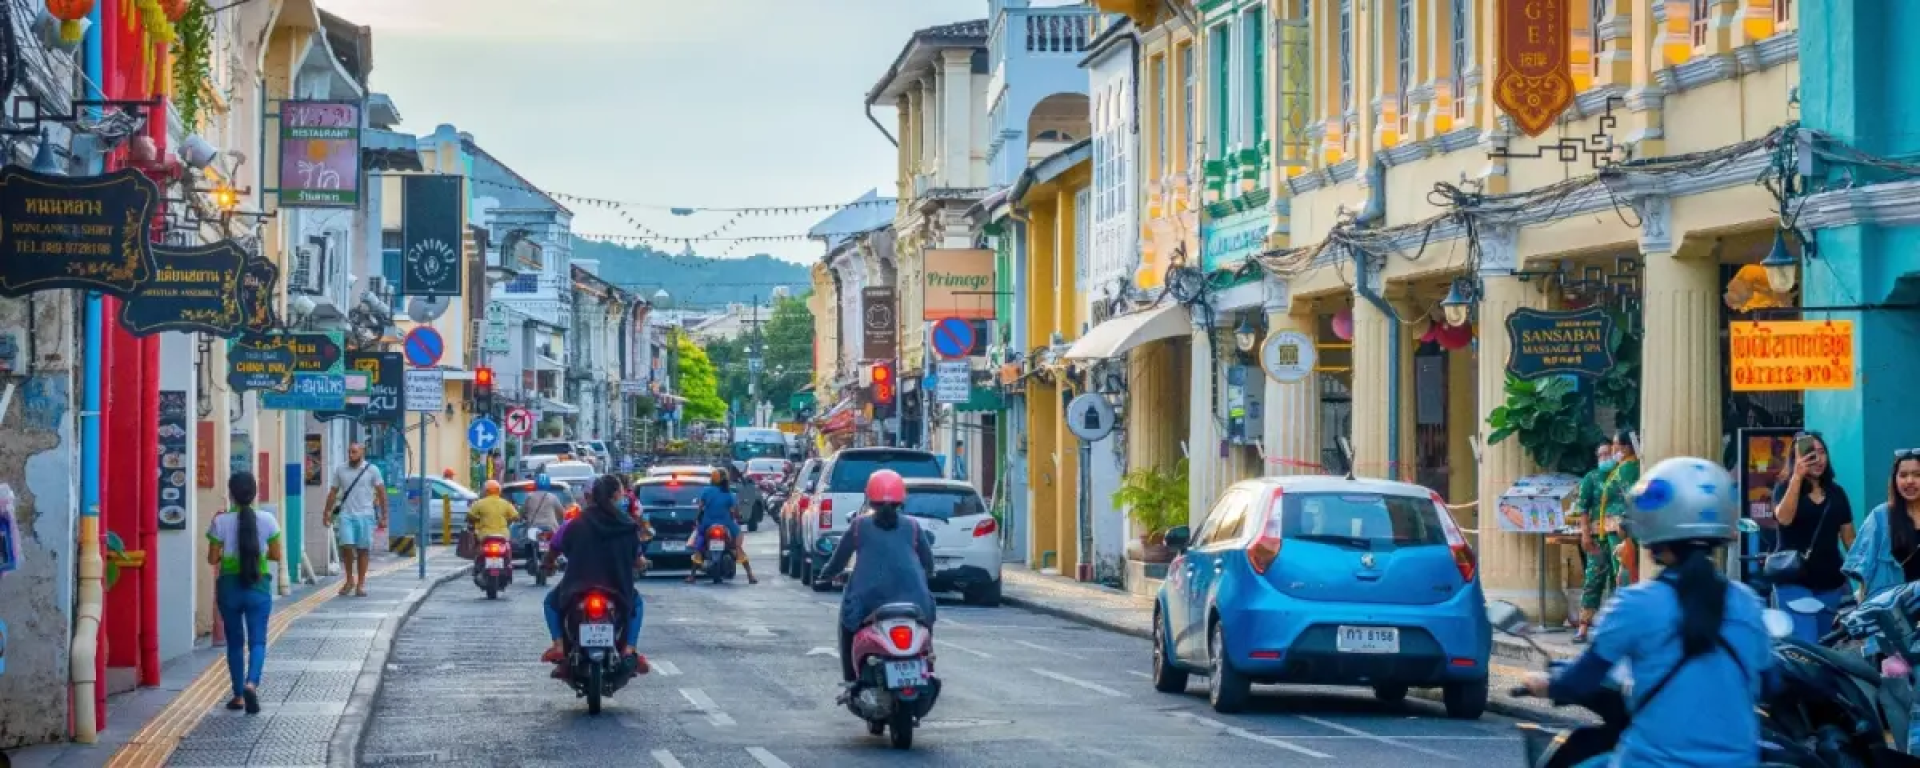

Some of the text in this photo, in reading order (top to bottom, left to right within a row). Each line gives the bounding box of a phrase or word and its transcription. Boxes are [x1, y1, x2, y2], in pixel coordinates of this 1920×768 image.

[292, 128, 349, 137] RESTAURANT
[407, 238, 456, 262] CHINO
[1522, 330, 1600, 343] SANSABAI
[1522, 344, 1568, 354] MASSAGE
[1584, 344, 1601, 353] SPA
[236, 362, 285, 371] CHINA INN
